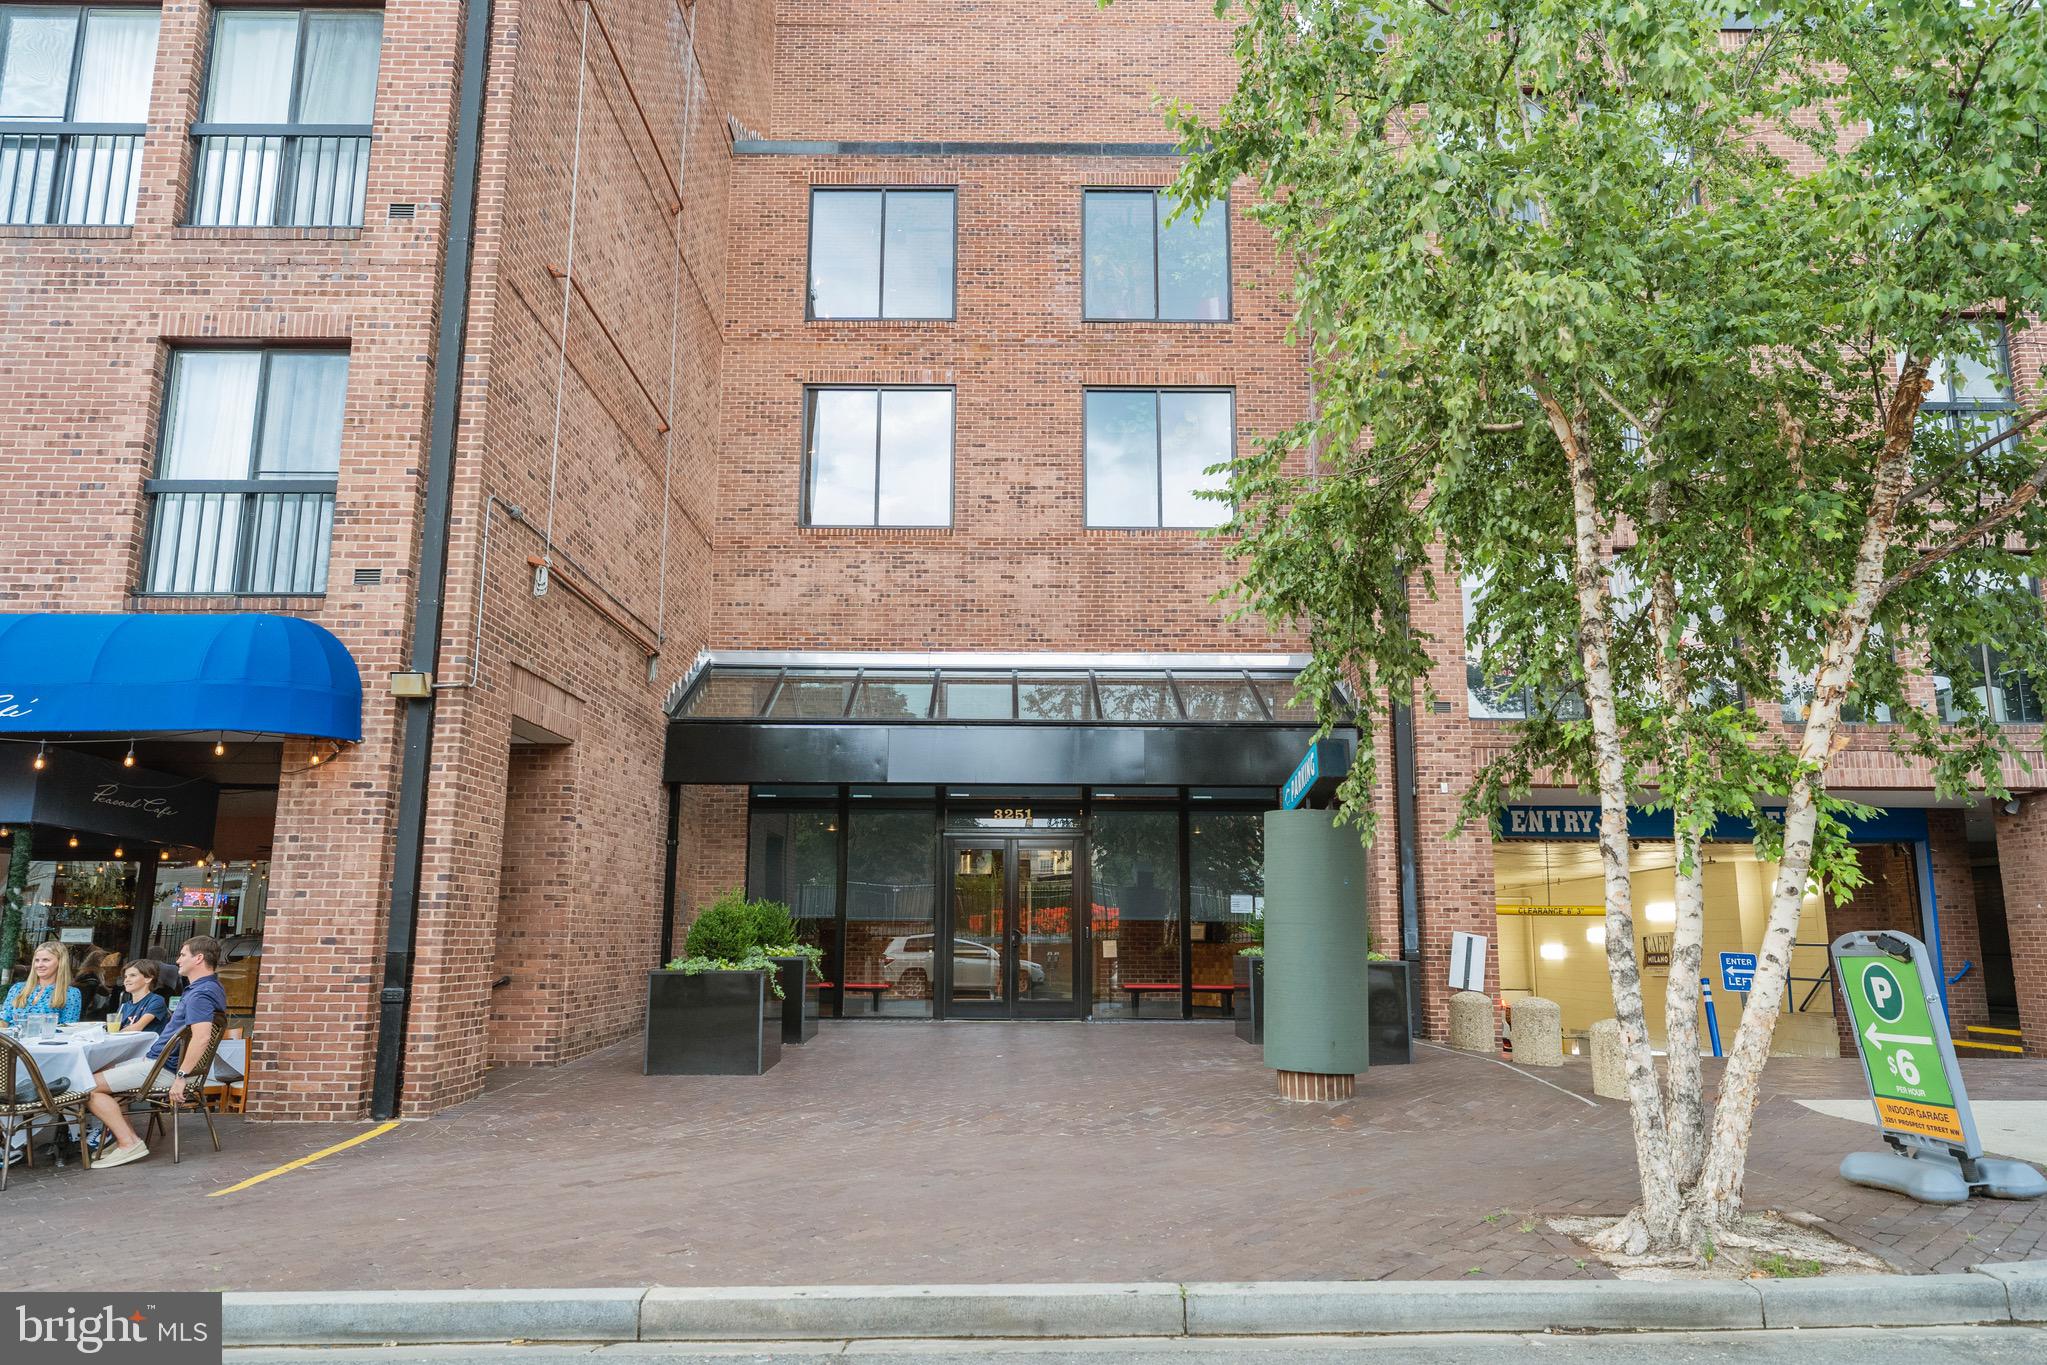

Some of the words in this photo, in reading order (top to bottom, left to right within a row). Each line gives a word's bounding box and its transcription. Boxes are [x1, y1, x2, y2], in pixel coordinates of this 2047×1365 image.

[1290, 752, 1315, 803] PARKING
[92, 783, 142, 809] Peacock
[993, 808, 1033, 819] 3251
[1510, 810, 1594, 833] ENTRY
[1518, 907, 1564, 916] CLEARANCE
[1647, 954, 1669, 964] MILANO
[1725, 957, 1753, 966] ENTER
[1870, 976, 1893, 1009] P
[1887, 1048, 1921, 1086] $6
[1895, 1085, 1909, 1095] PER
[1908, 1087, 1927, 1097] HOUR
[1886, 1104, 1916, 1117] INDOOR
[1916, 1109, 1950, 1123] GARAGE
[1884, 1116, 1898, 1124] 3251
[1898, 1119, 1925, 1130] PROSPECT
[1926, 1124, 1949, 1135] STREET
